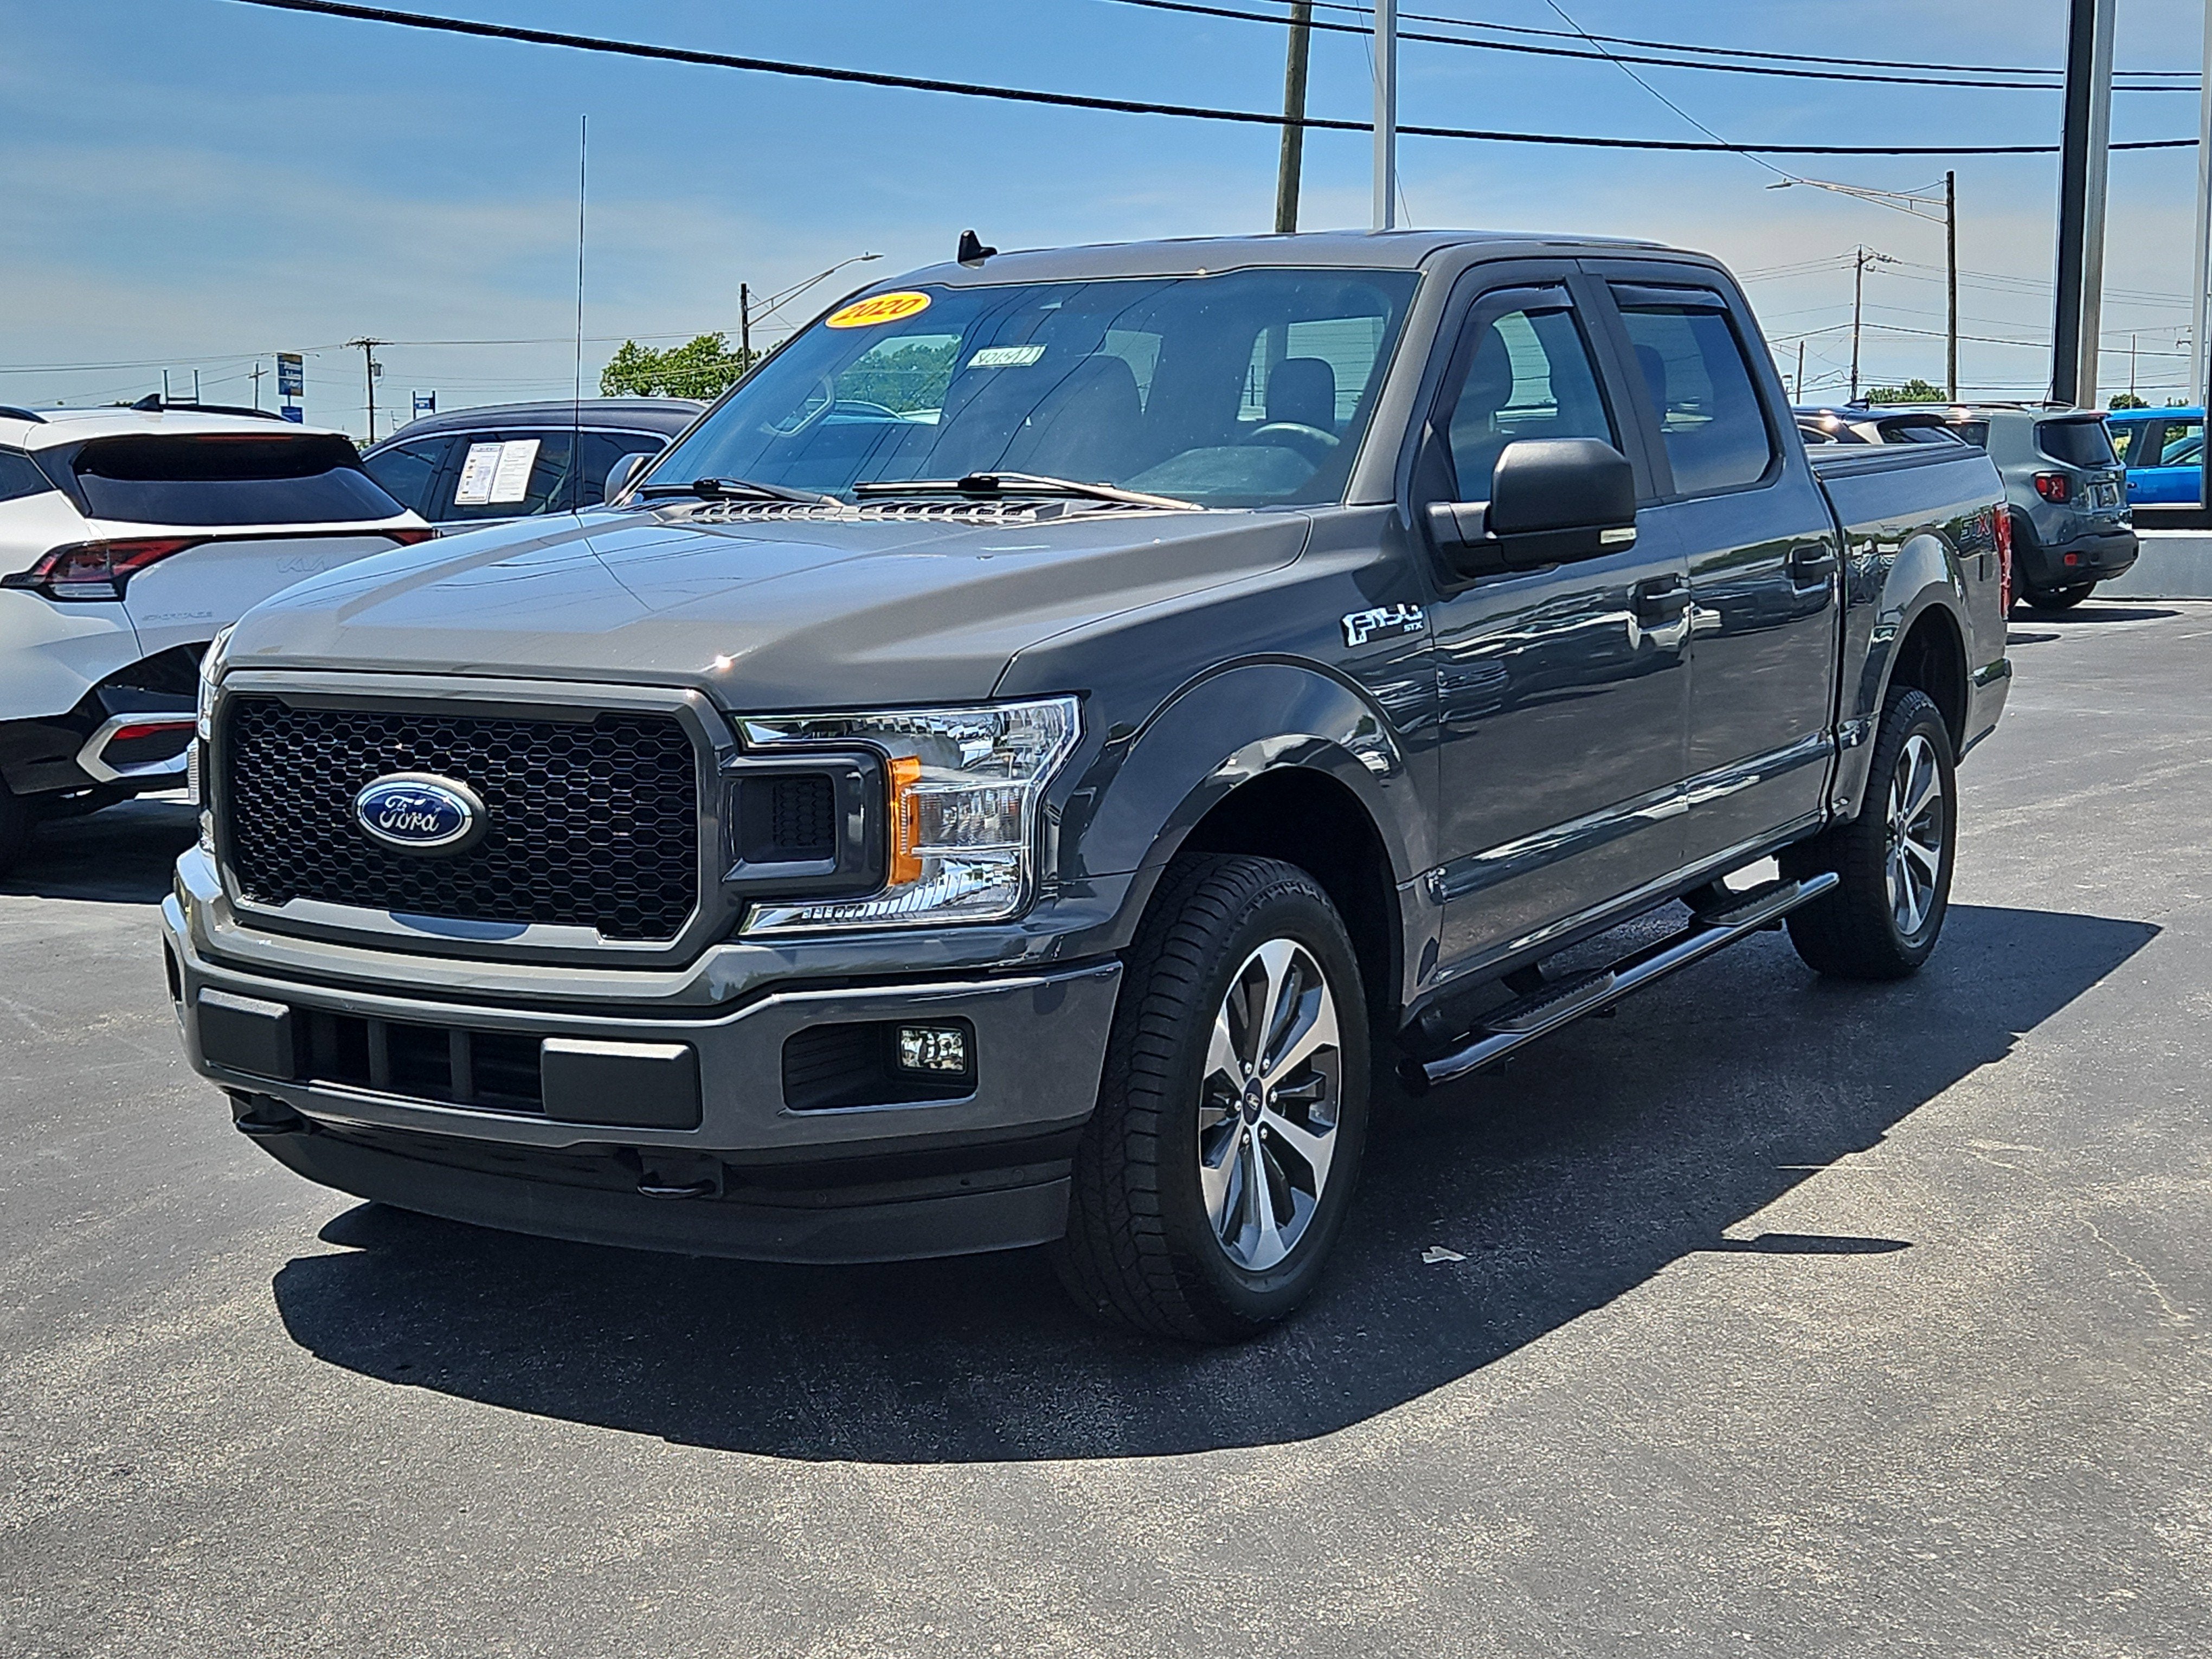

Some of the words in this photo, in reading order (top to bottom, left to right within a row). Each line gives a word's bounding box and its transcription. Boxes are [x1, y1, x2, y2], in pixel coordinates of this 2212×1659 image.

[833, 299, 922, 322] 2020
[1404, 621, 1424, 633] STX
[380, 795, 442, 832] Ford
